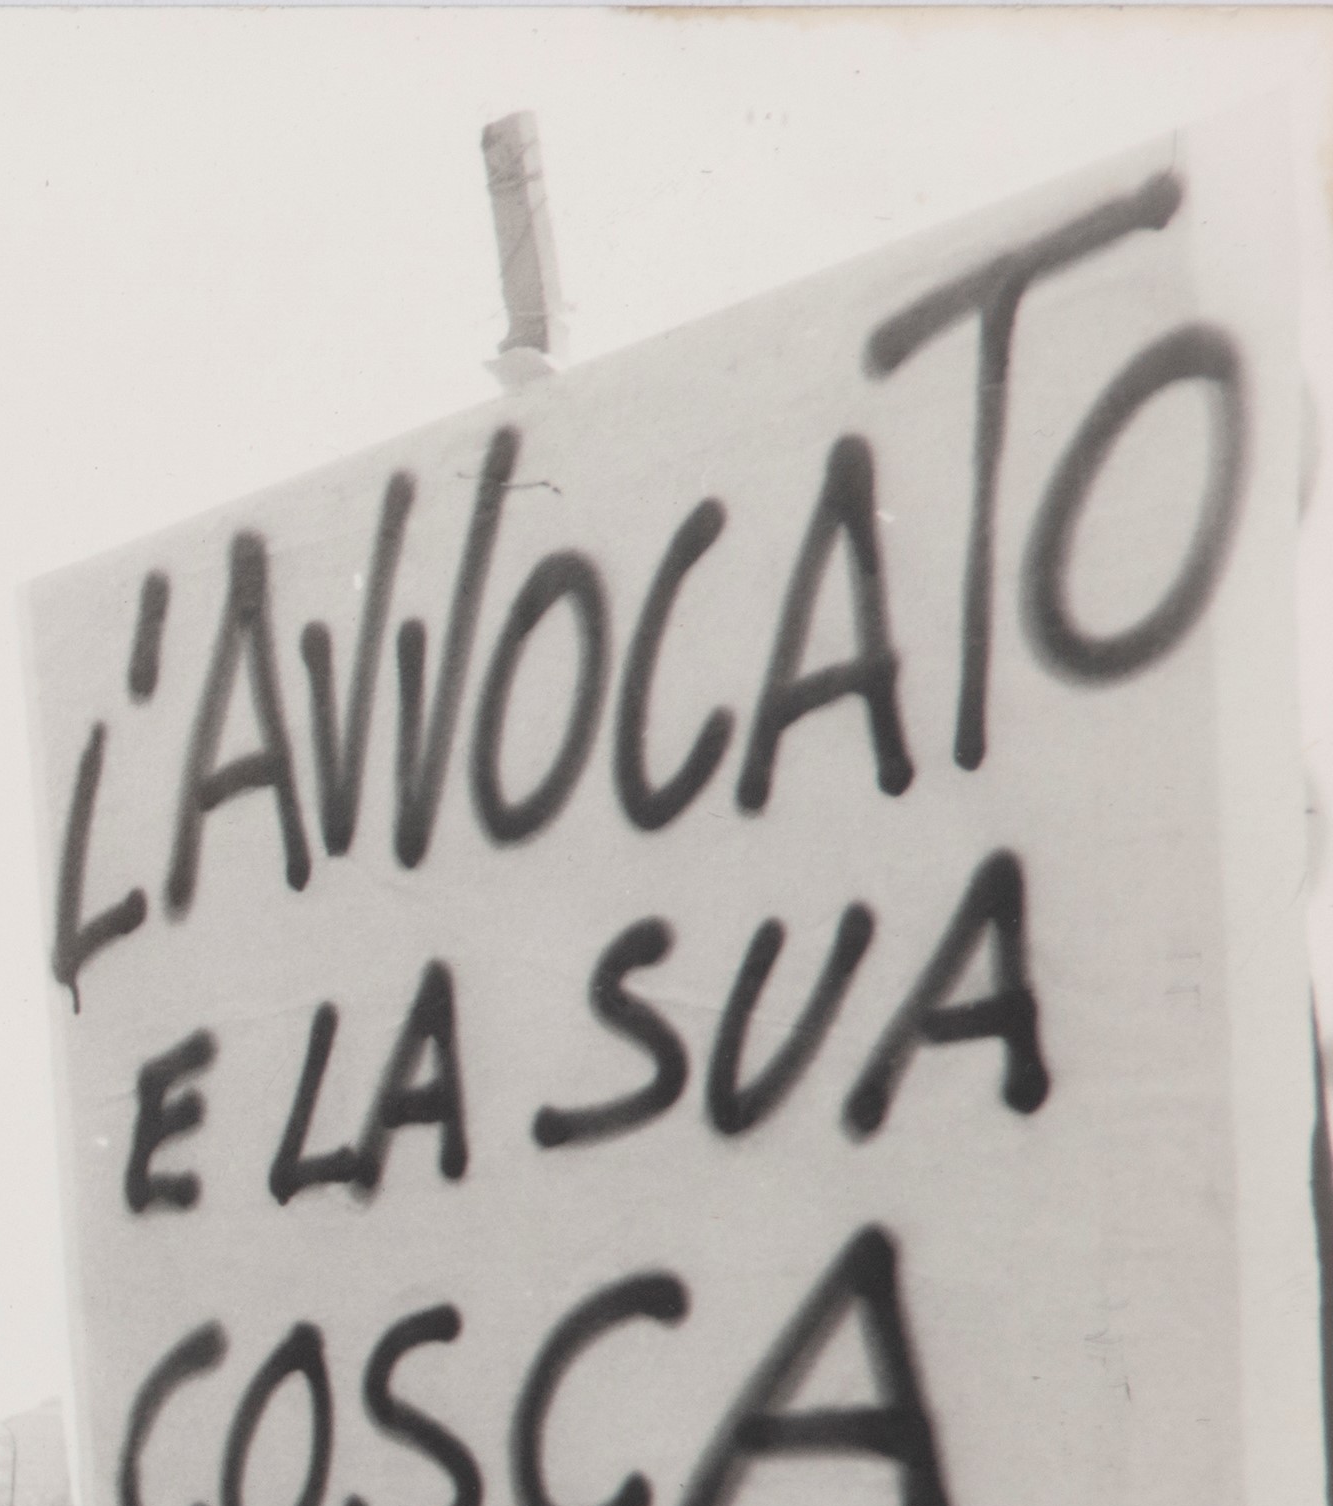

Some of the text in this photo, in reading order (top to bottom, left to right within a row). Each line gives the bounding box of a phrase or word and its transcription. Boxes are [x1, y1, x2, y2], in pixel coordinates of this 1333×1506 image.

[56, 173, 1246, 1014] L'AVVOCATO
[122, 846, 1056, 1219] E LA SUA
